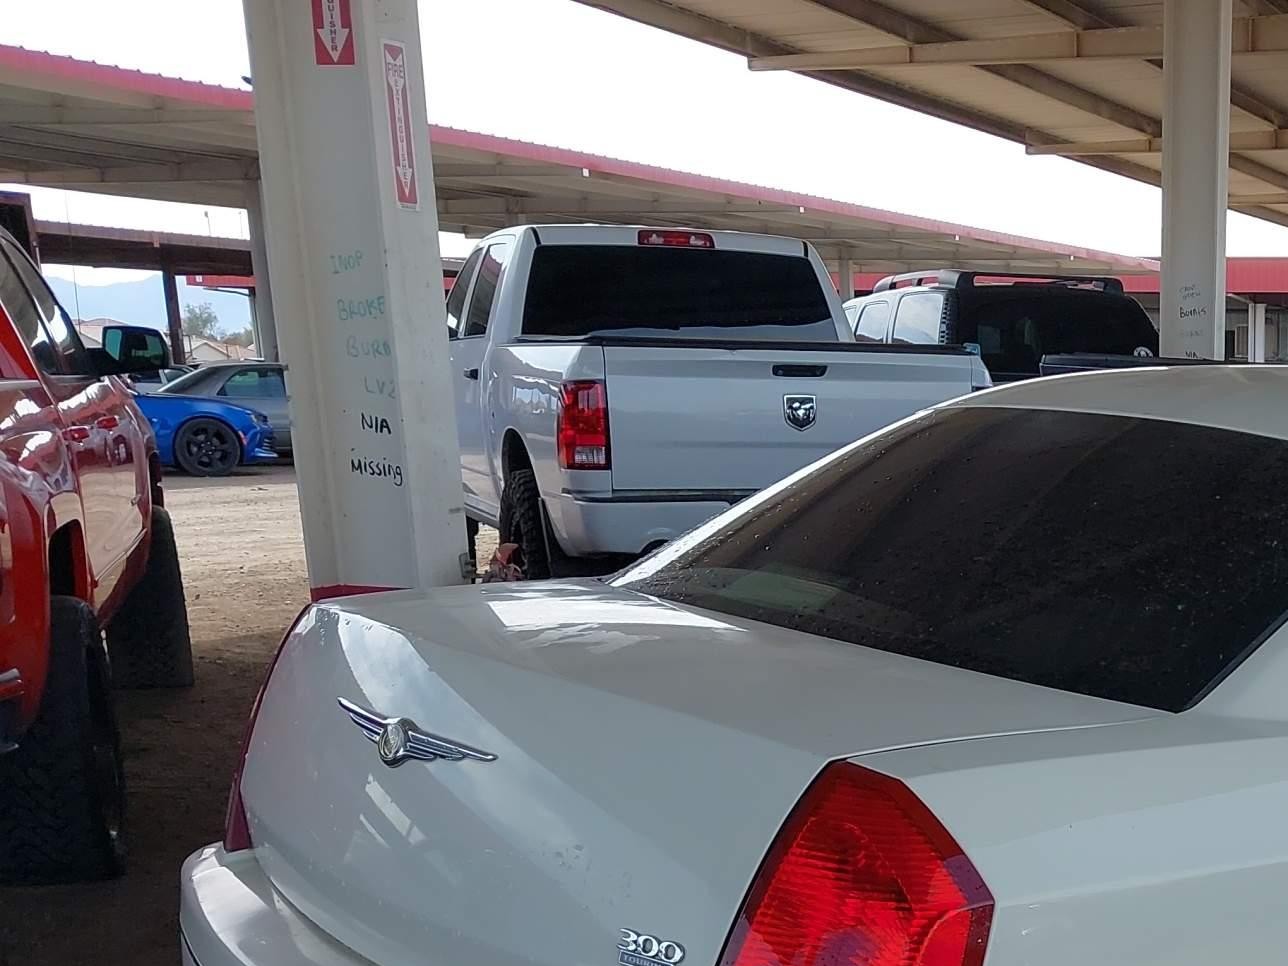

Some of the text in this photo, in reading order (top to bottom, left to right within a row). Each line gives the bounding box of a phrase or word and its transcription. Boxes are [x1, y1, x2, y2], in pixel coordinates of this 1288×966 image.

[386, 62, 405, 80] FIRE
[394, 79, 408, 188] EXTINGUISHER
[350, 457, 403, 487] Missing
[616, 928, 683, 963] 300
